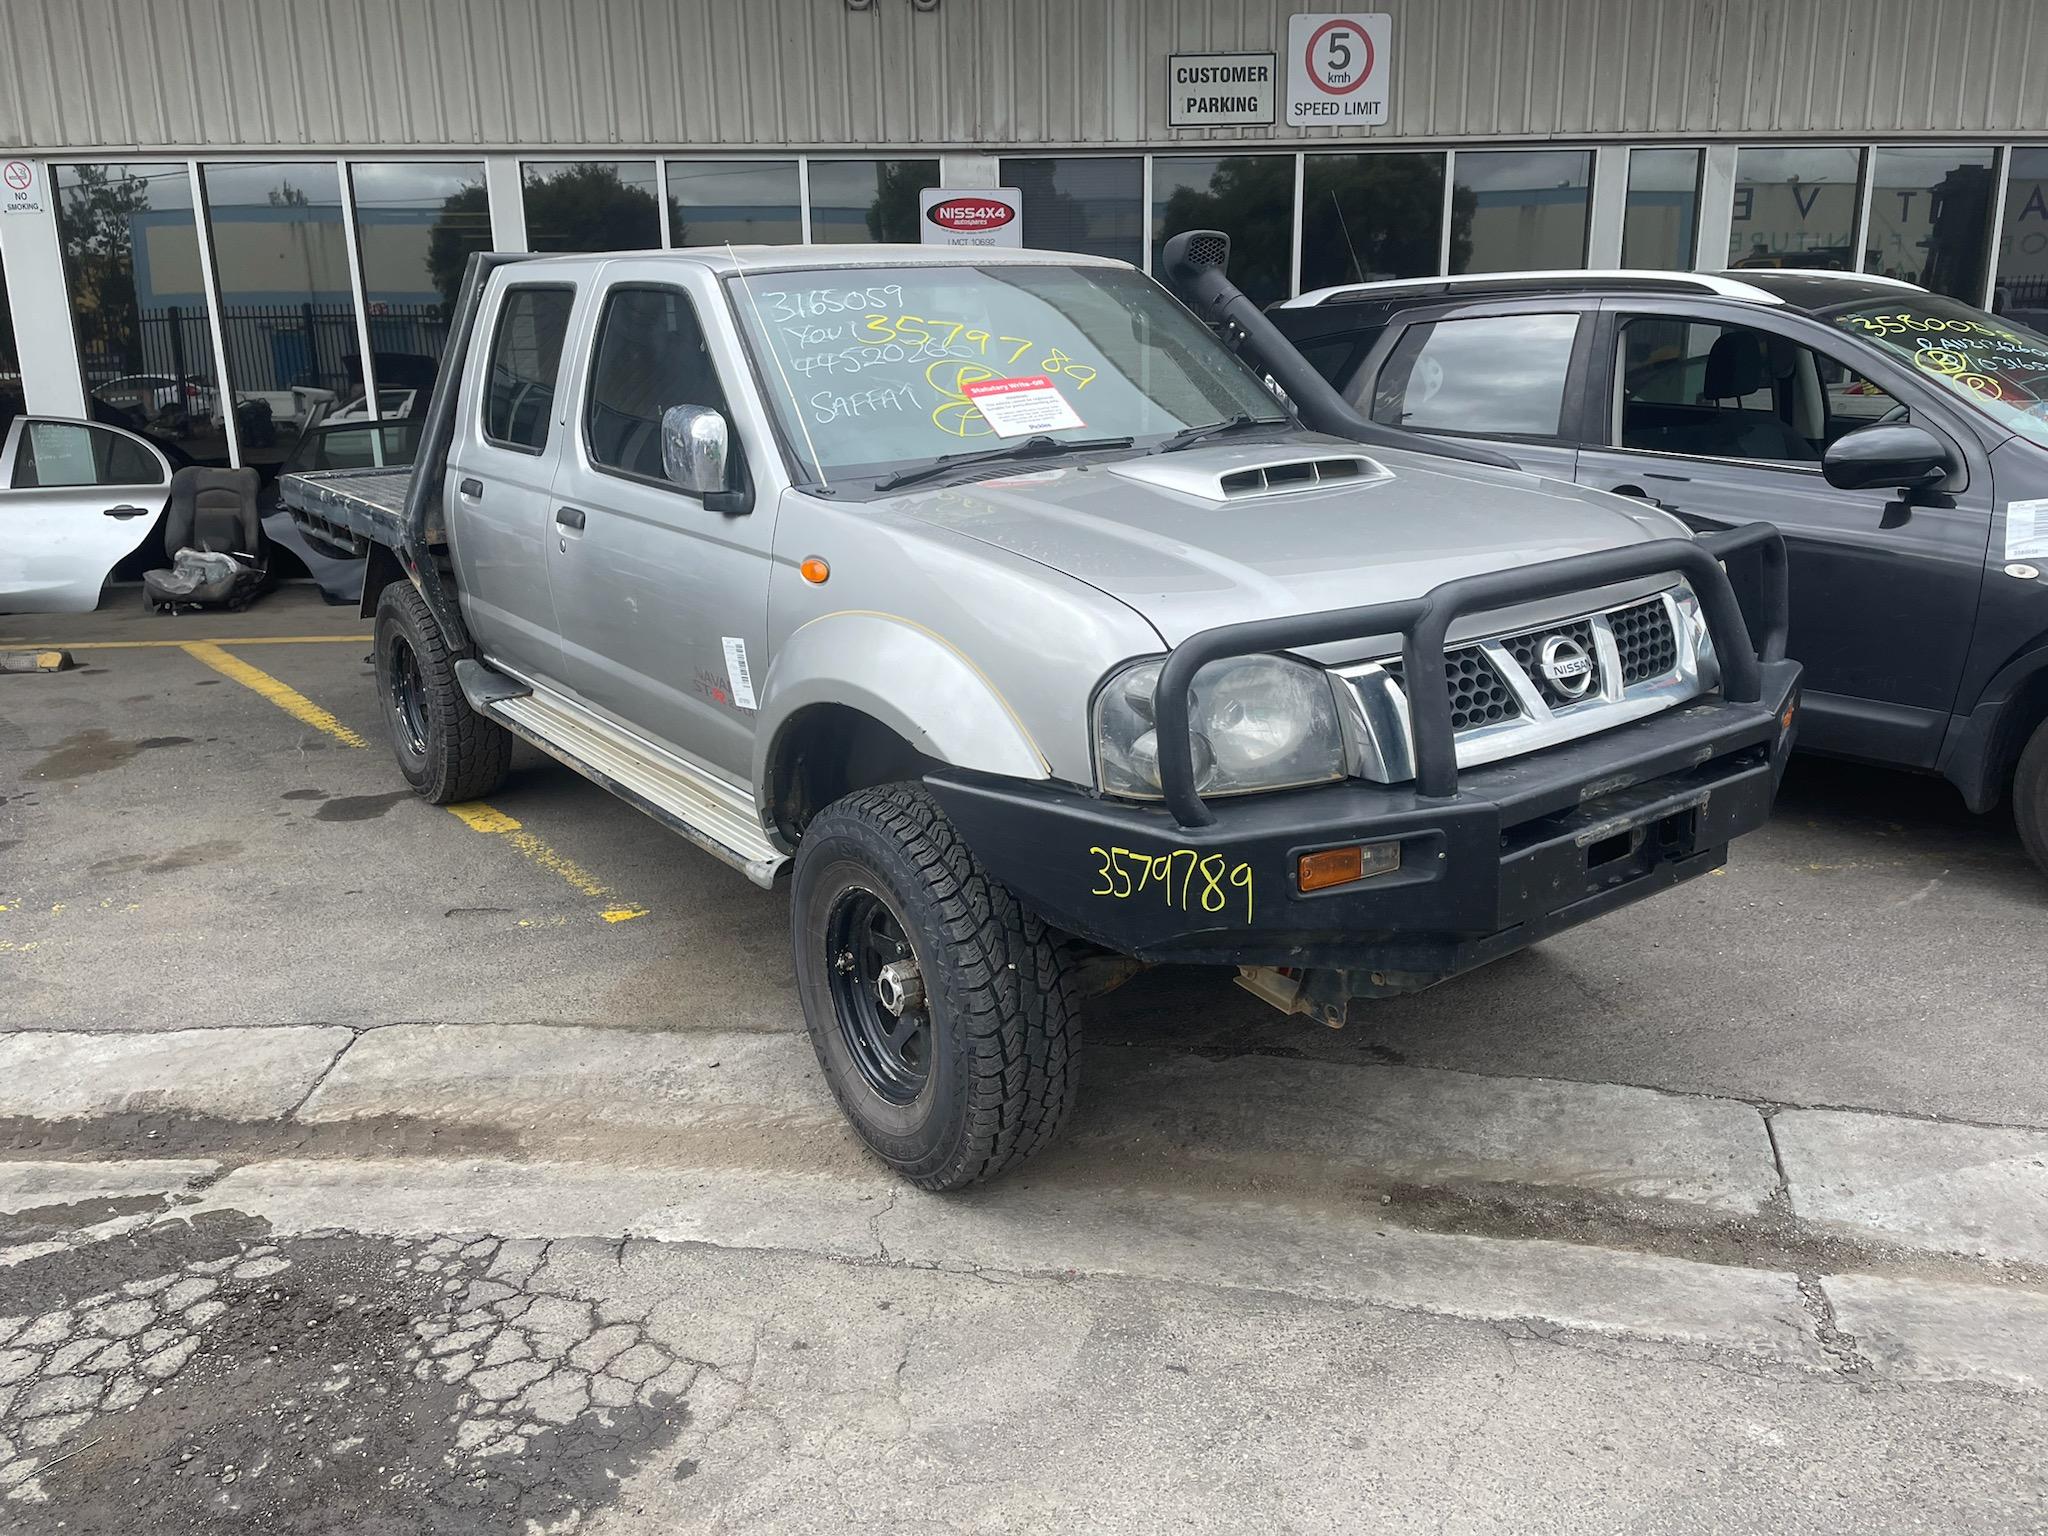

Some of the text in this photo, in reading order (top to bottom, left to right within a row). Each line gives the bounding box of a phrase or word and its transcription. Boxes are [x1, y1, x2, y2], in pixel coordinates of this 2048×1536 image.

[1327, 32, 1351, 70] 5
[1176, 66, 1269, 84] CUSTOMER
[1327, 72, 1351, 84] kmh
[1186, 96, 1258, 113] PARKING
[1294, 101, 1382, 116] SPEED LIMIT
[14, 192, 28, 201] NO
[7, 203, 39, 211] SMOKING
[939, 207, 1006, 219] NISS4X4
[762, 285, 903, 322] 3165059
[858, 314, 1096, 390] 3579789
[1553, 658, 1593, 676] NISSAN
[1089, 846, 1253, 924] 3579789
